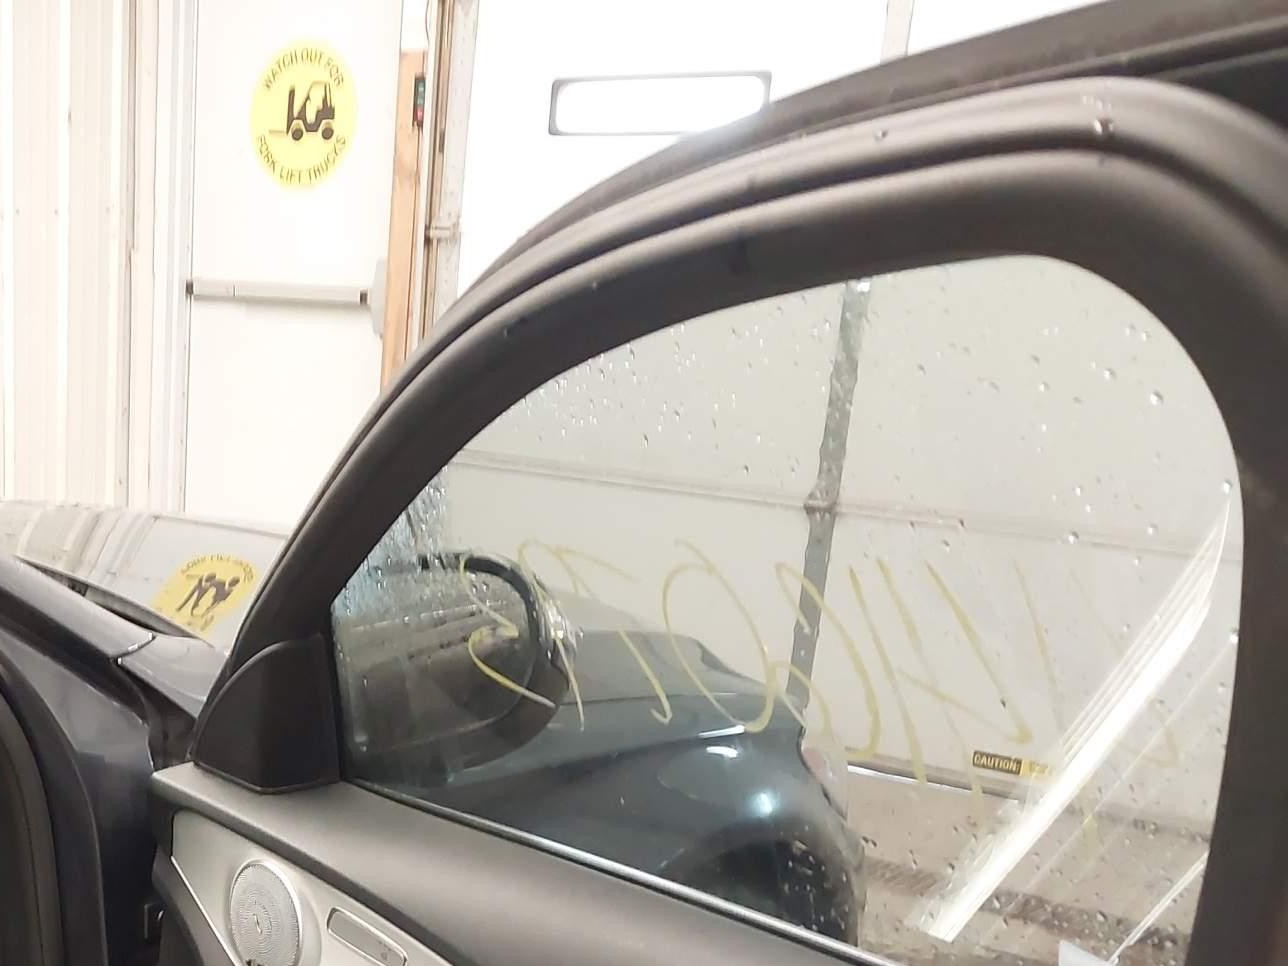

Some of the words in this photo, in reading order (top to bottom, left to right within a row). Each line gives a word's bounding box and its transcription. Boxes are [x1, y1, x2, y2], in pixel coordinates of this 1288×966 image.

[264, 50, 299, 90] WATCH
[300, 47, 325, 65] OUT
[325, 58, 344, 87] FOR
[279, 165, 302, 184] LIFT
[307, 135, 346, 184] TRUCKS
[973, 752, 1021, 773] CAUTION:
